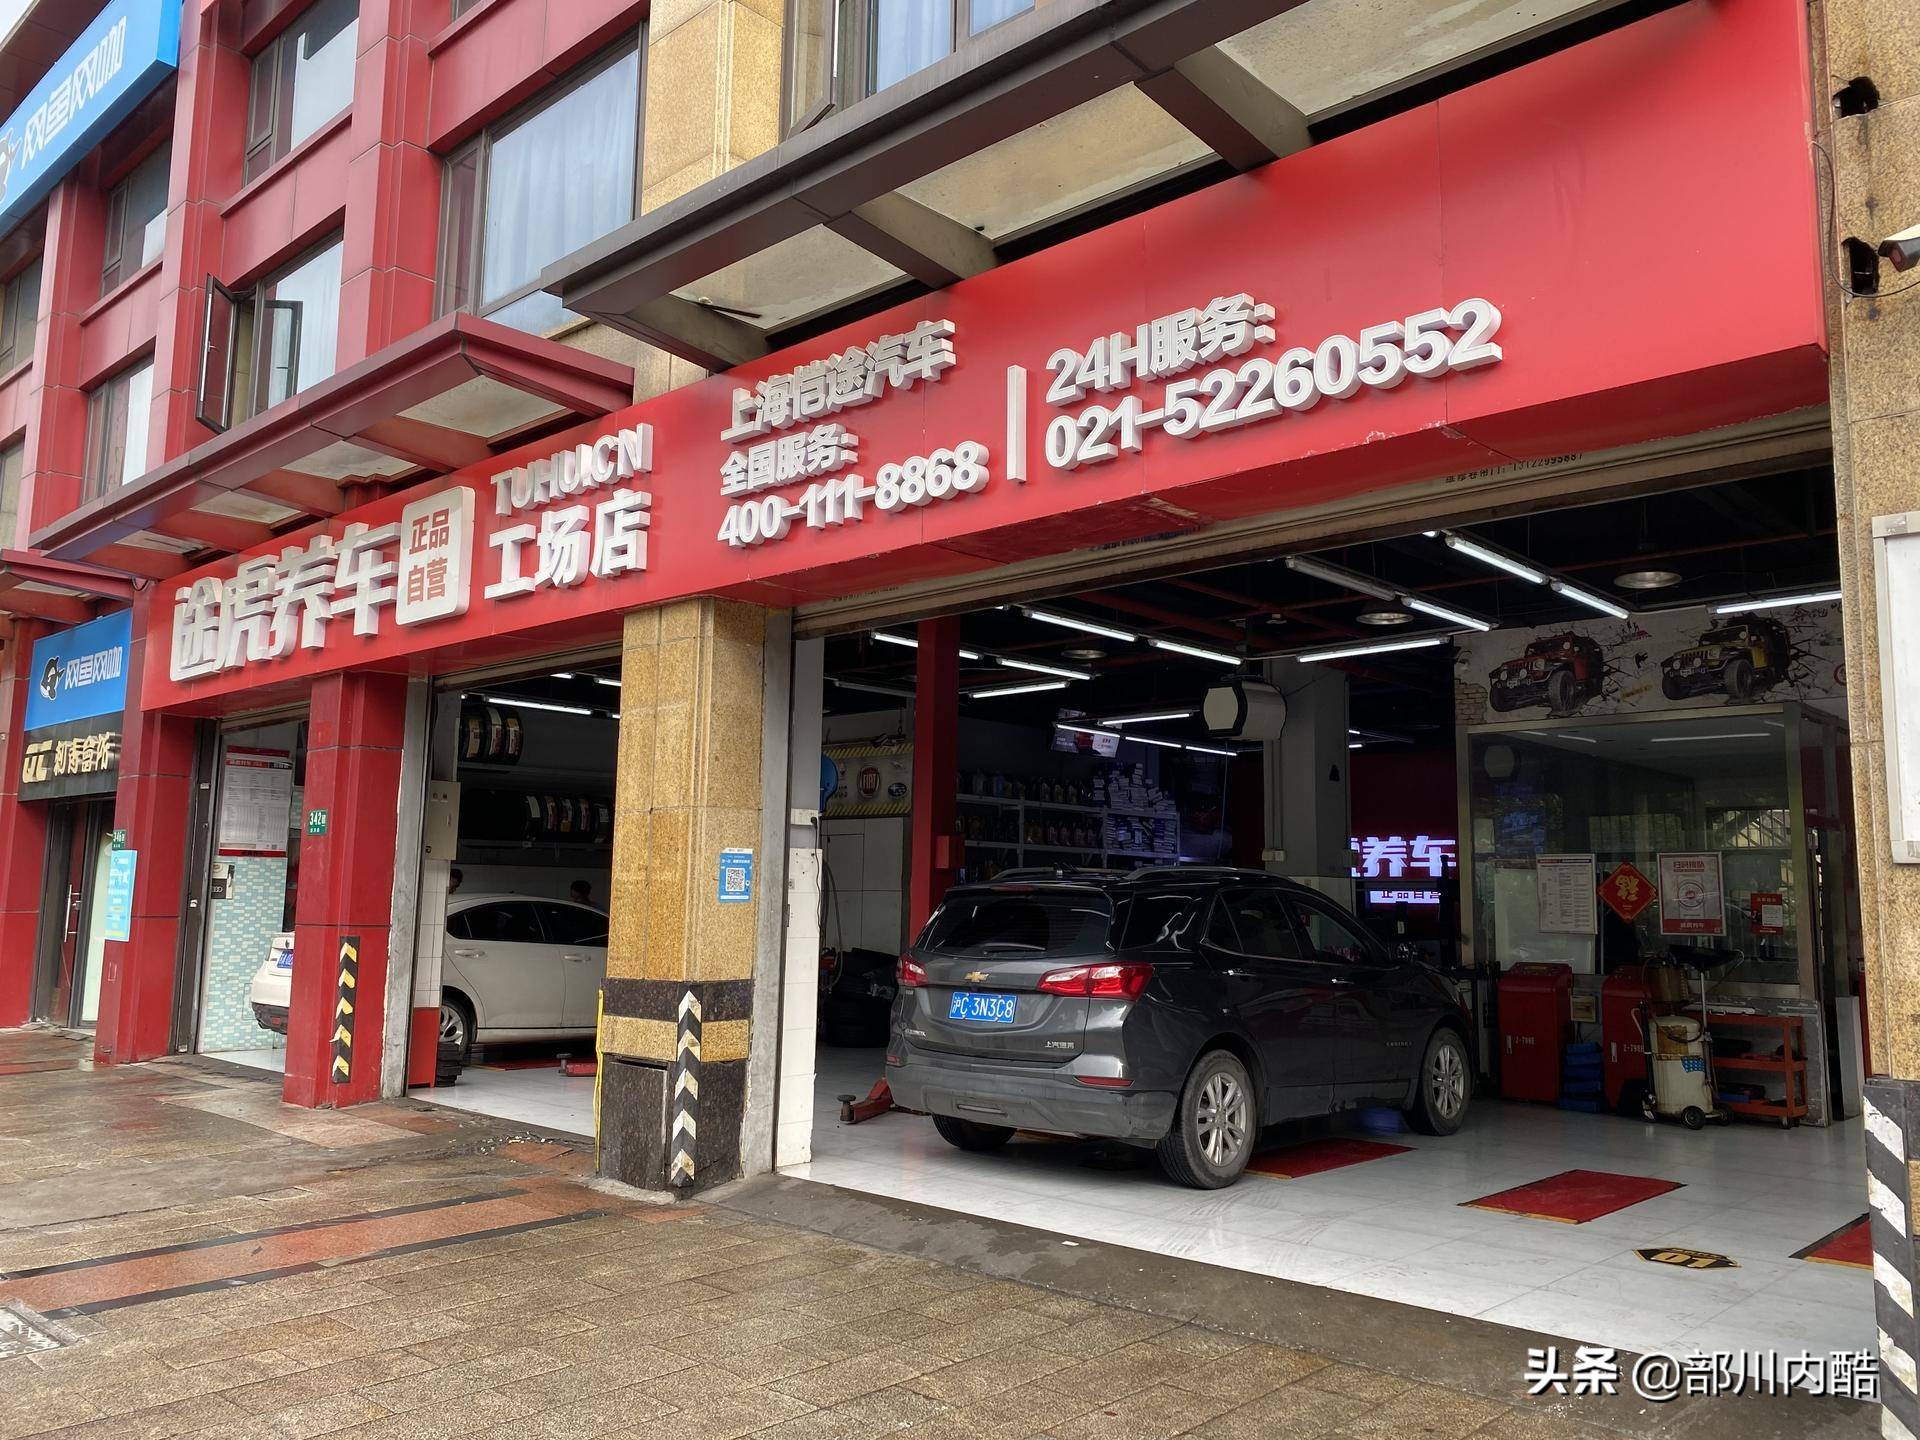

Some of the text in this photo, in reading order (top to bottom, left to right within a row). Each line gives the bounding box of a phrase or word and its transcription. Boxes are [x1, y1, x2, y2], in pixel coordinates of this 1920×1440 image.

[21, 16, 127, 170] 网鱼网咖
[1045, 293, 1276, 407] 24H服务:
[1045, 297, 1503, 470] 021-52260552
[491, 423, 653, 516] TUHU.CN
[717, 440, 990, 547] 400-111-8868
[720, 423, 859, 497] 全国服务:
[406, 557, 449, 606] 自营
[409, 507, 449, 555] 正品
[484, 488, 652, 600] 工场店
[169, 522, 402, 682] 途虎养车
[65, 646, 123, 690] 网鱼网咖
